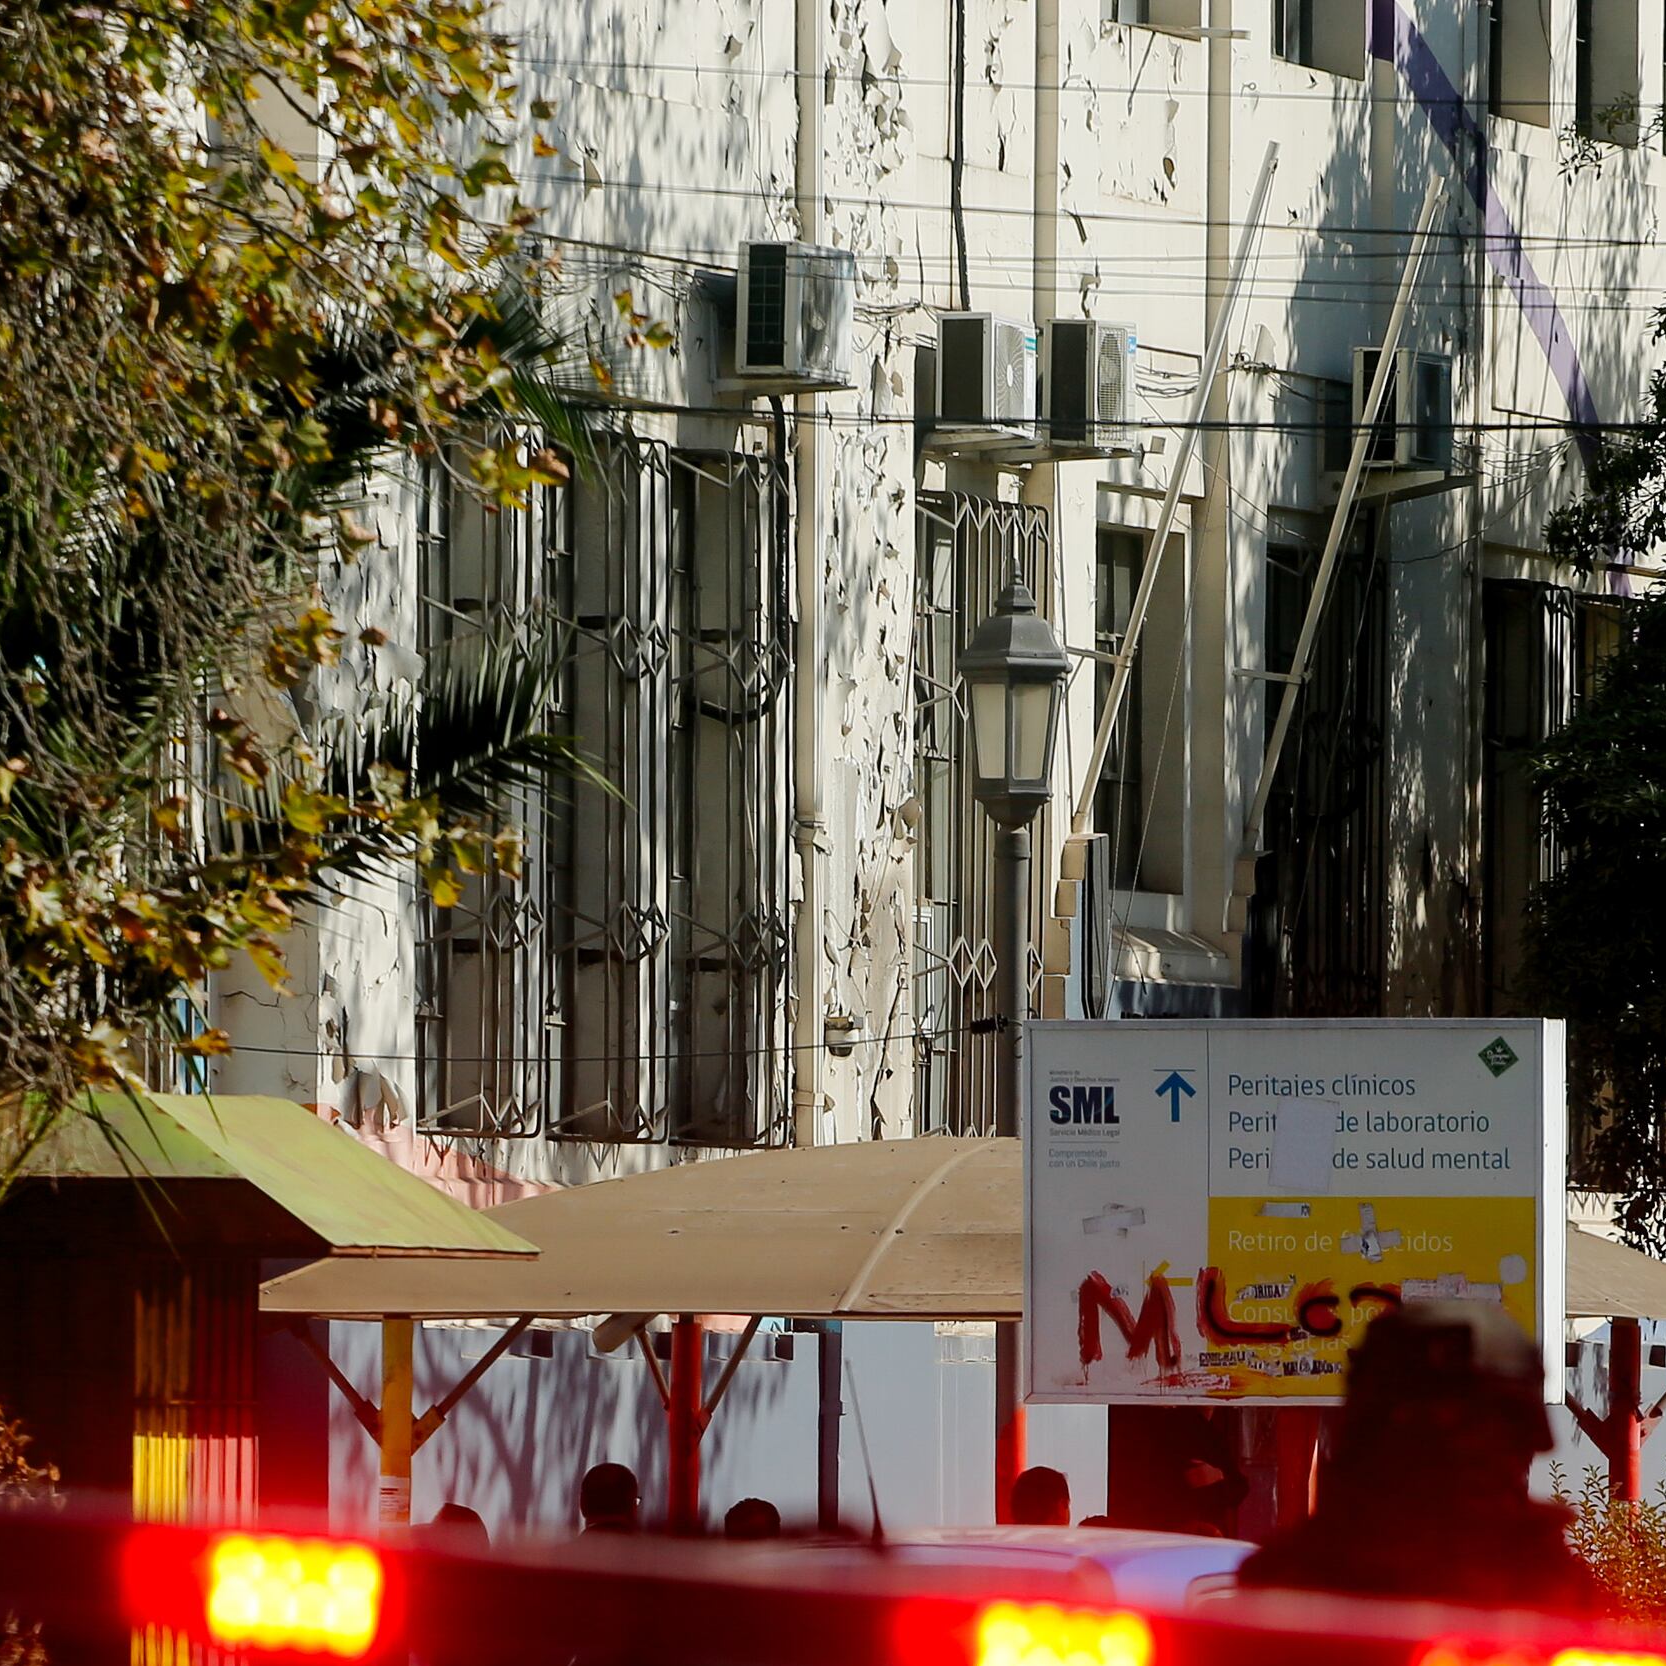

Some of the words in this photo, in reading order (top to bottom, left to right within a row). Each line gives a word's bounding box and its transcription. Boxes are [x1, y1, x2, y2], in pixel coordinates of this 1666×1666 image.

[1228, 1074, 1326, 1098] Peritajes
[1331, 1073, 1416, 1097] clínicos
[1049, 1085, 1120, 1125] SML
[1228, 1110, 1277, 1133] Perit
[1366, 1110, 1490, 1133] laboratorio
[1332, 1147, 1359, 1170] de
[1365, 1147, 1425, 1170] salud
[1432, 1147, 1511, 1170] mental
[1228, 1230, 1297, 1252] Retiro
[1304, 1230, 1333, 1252] de
